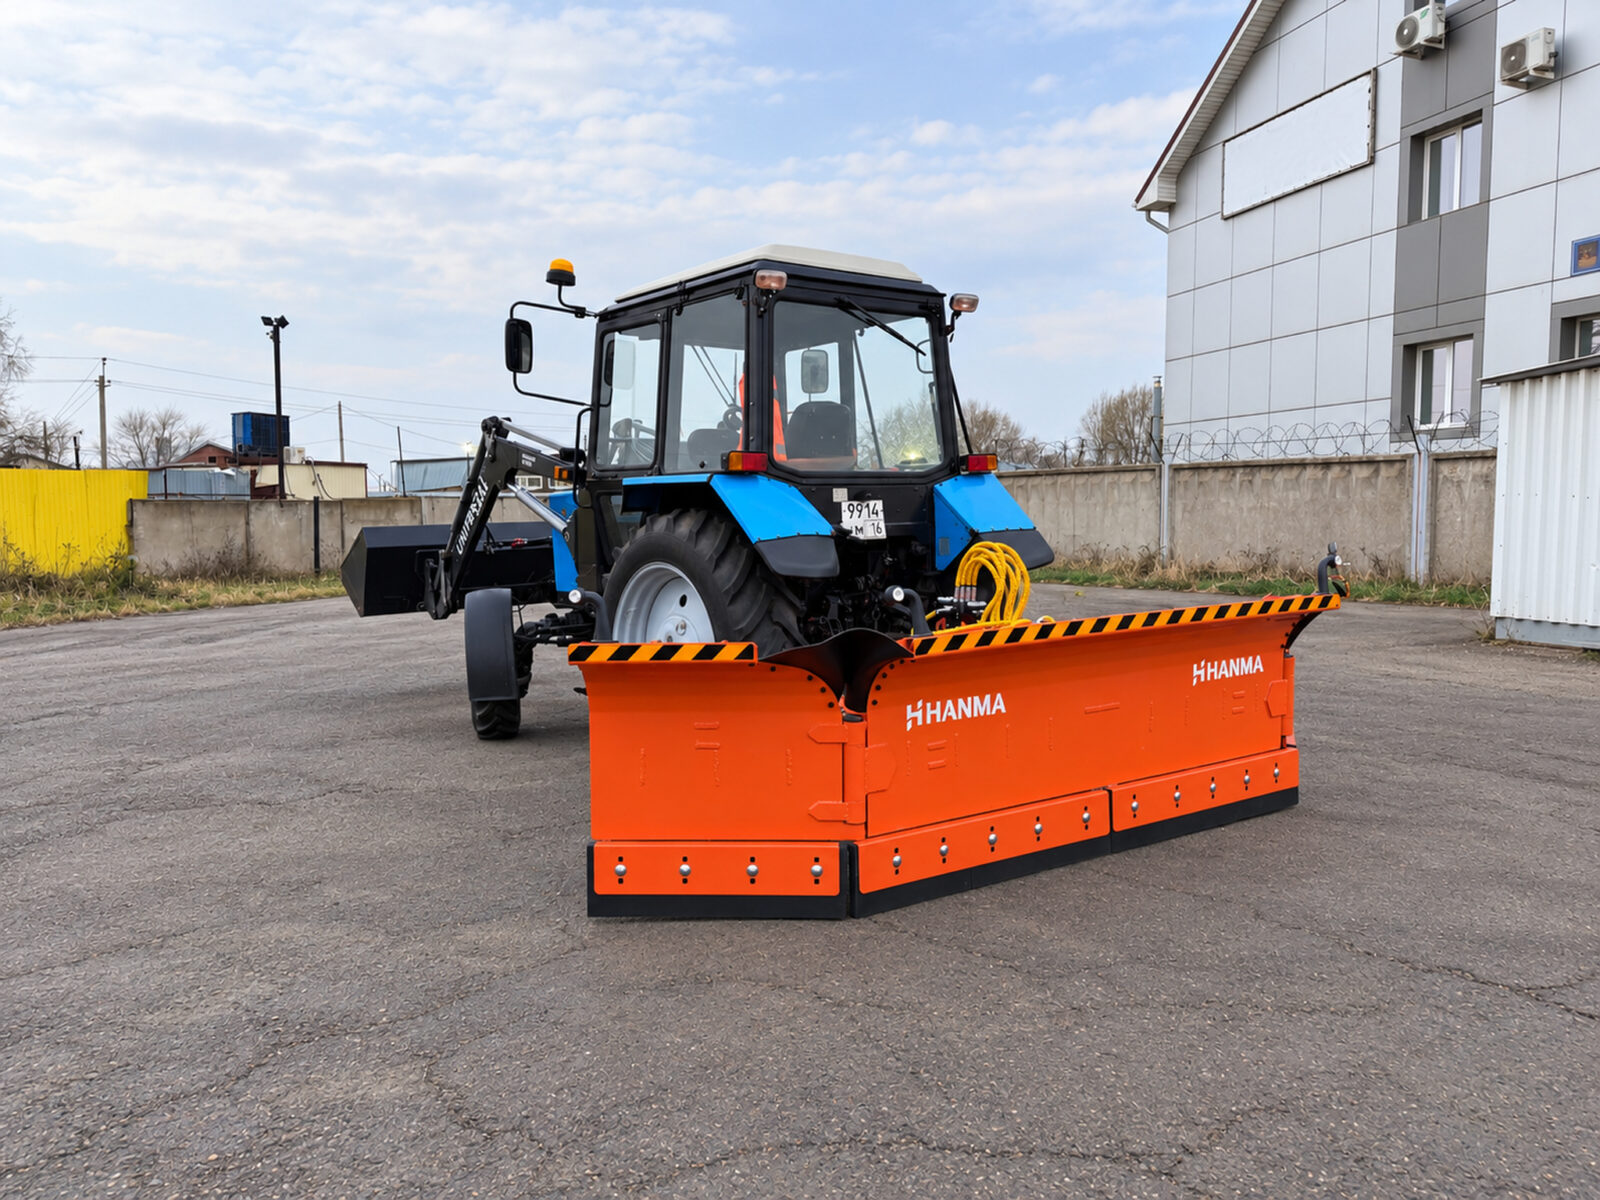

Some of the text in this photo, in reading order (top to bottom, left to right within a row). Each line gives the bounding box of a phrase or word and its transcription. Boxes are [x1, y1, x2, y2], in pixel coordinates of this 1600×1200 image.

[847, 502, 879, 519] 9914
[870, 521, 883, 537] 16
[1207, 654, 1264, 681] HANMA
[926, 692, 1007, 724] HANMA
